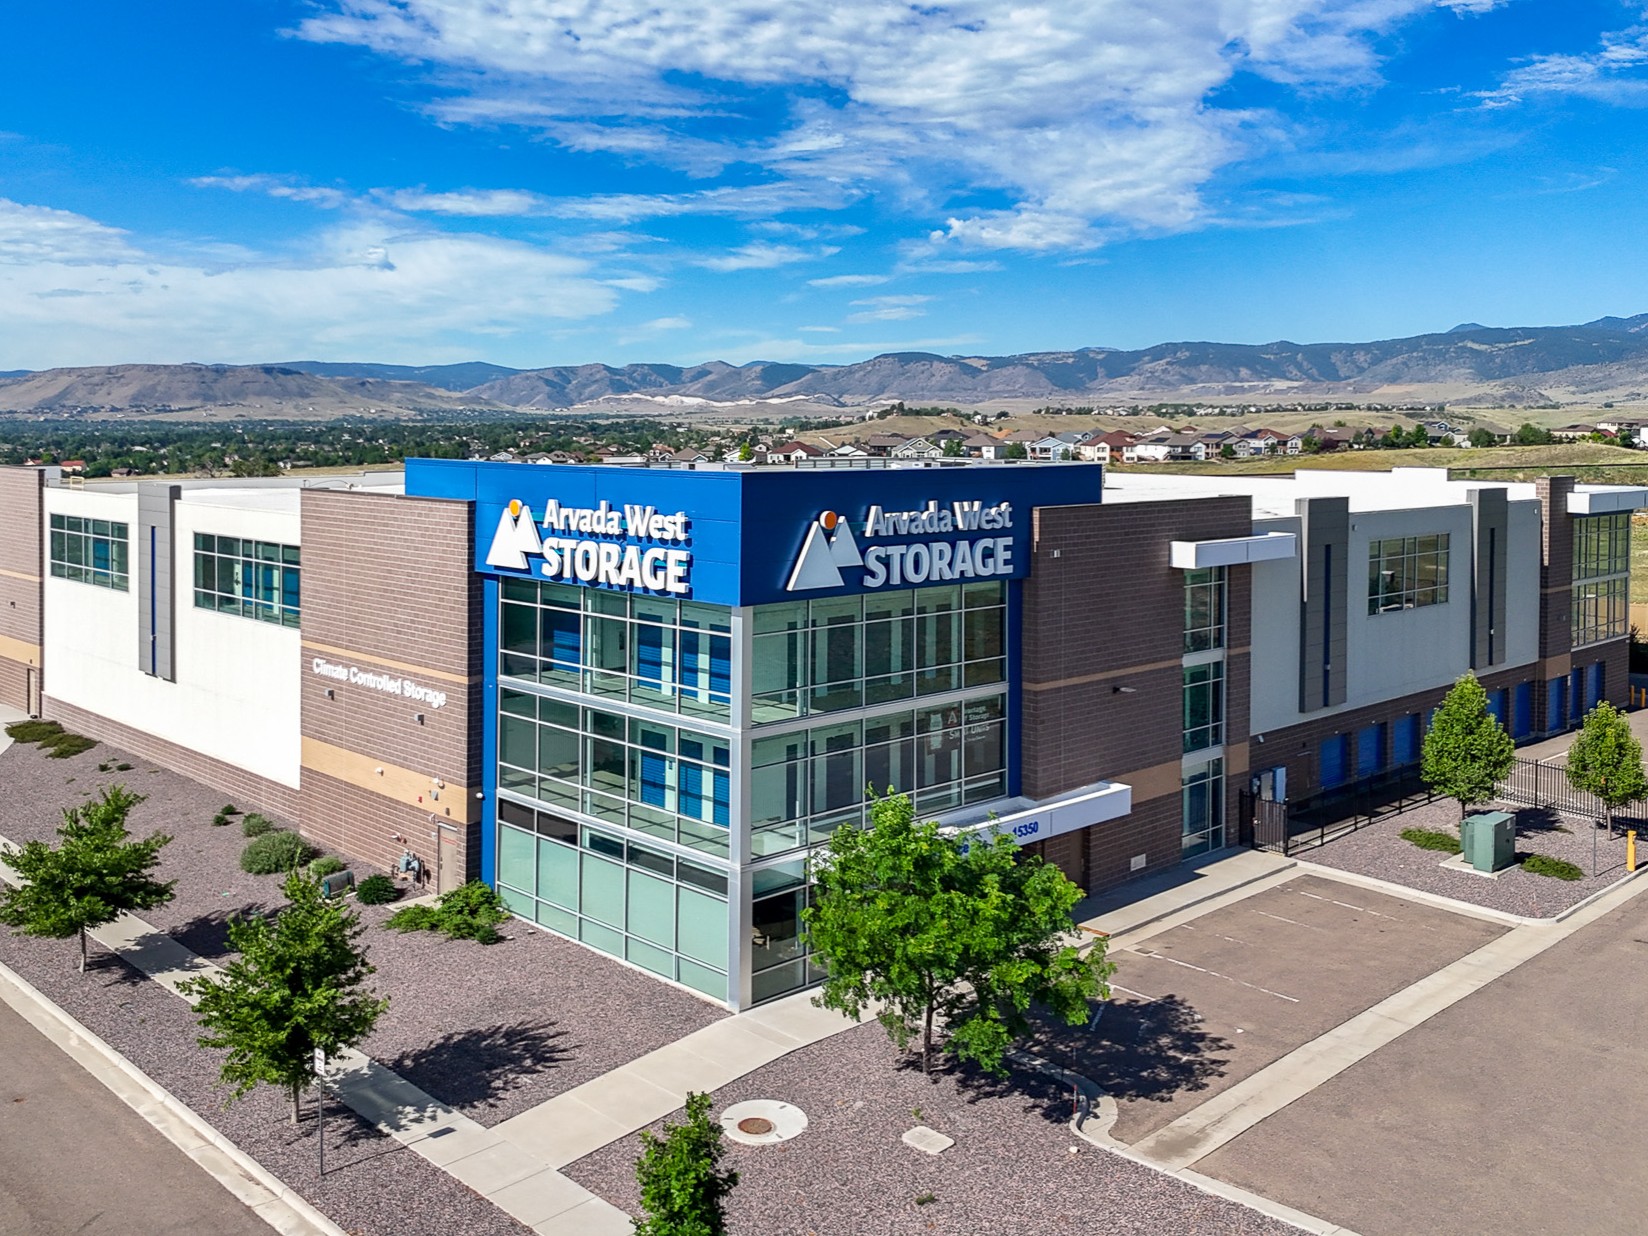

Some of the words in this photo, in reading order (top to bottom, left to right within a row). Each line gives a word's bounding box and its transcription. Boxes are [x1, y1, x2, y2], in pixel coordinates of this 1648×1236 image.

[542, 498, 622, 535] Arvada
[623, 503, 689, 541] West
[865, 500, 953, 537] Arvada
[953, 500, 1013, 531] West
[541, 536, 691, 593] STORAGE
[863, 536, 1014, 588] STORAGE
[312, 657, 349, 681] Climate
[349, 666, 402, 695] Controlled
[403, 680, 447, 709] Storage
[1012, 820, 1039, 838] 15350
